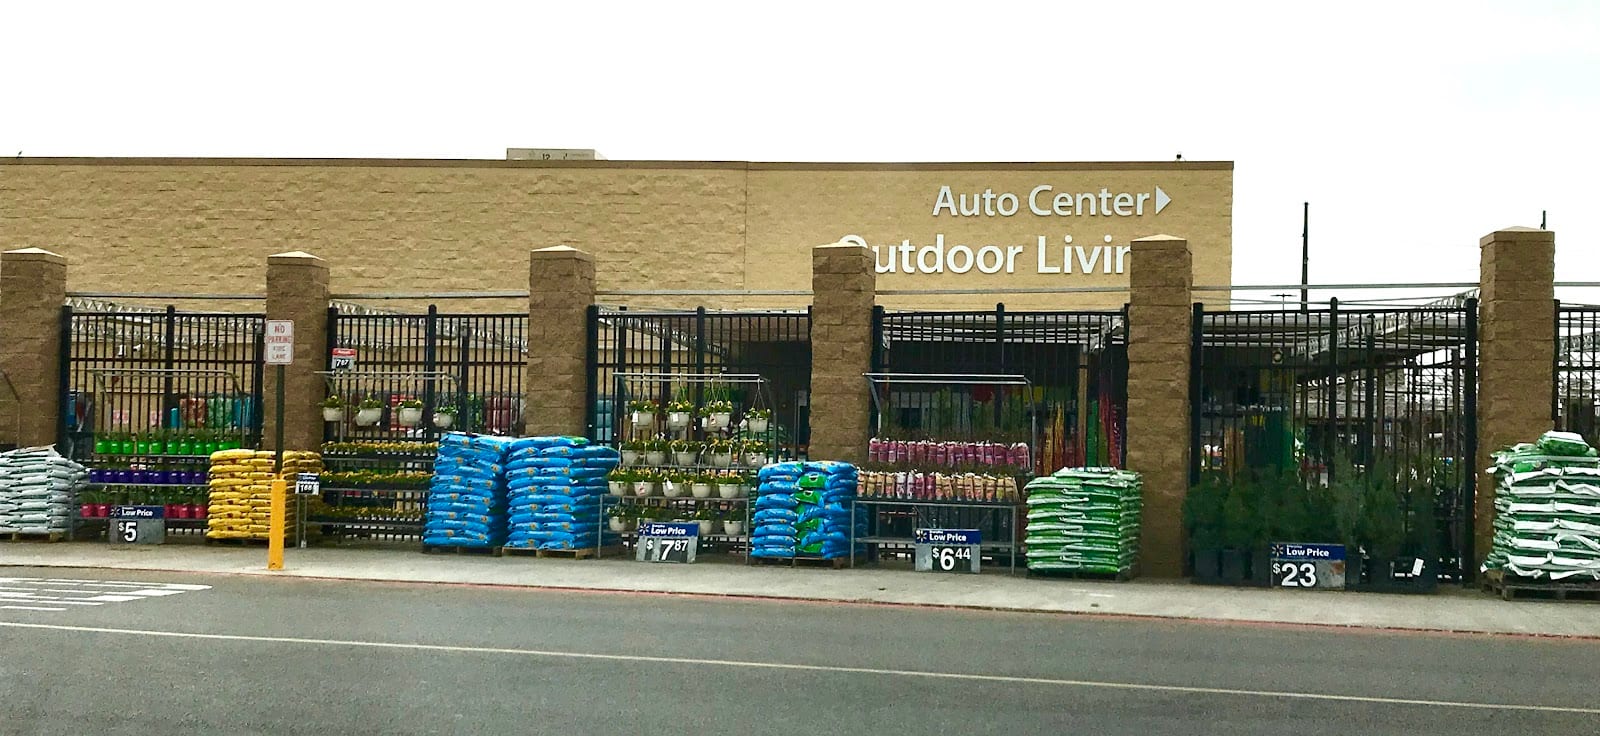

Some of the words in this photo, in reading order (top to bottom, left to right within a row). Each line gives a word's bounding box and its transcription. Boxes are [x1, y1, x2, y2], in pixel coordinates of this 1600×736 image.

[932, 185, 1019, 216] Auto
[1028, 184, 1150, 216] Center
[1037, 234, 1131, 274] Livin
[274, 325, 286, 334] NO
[121, 507, 136, 516] Low
[651, 527, 667, 535] Low
[667, 527, 686, 535] Price
[929, 533, 945, 541] Low
[946, 533, 967, 542] Price
[1286, 547, 1306, 556] Low
[1306, 548, 1330, 557] Price
[1272, 562, 1317, 587] $23
